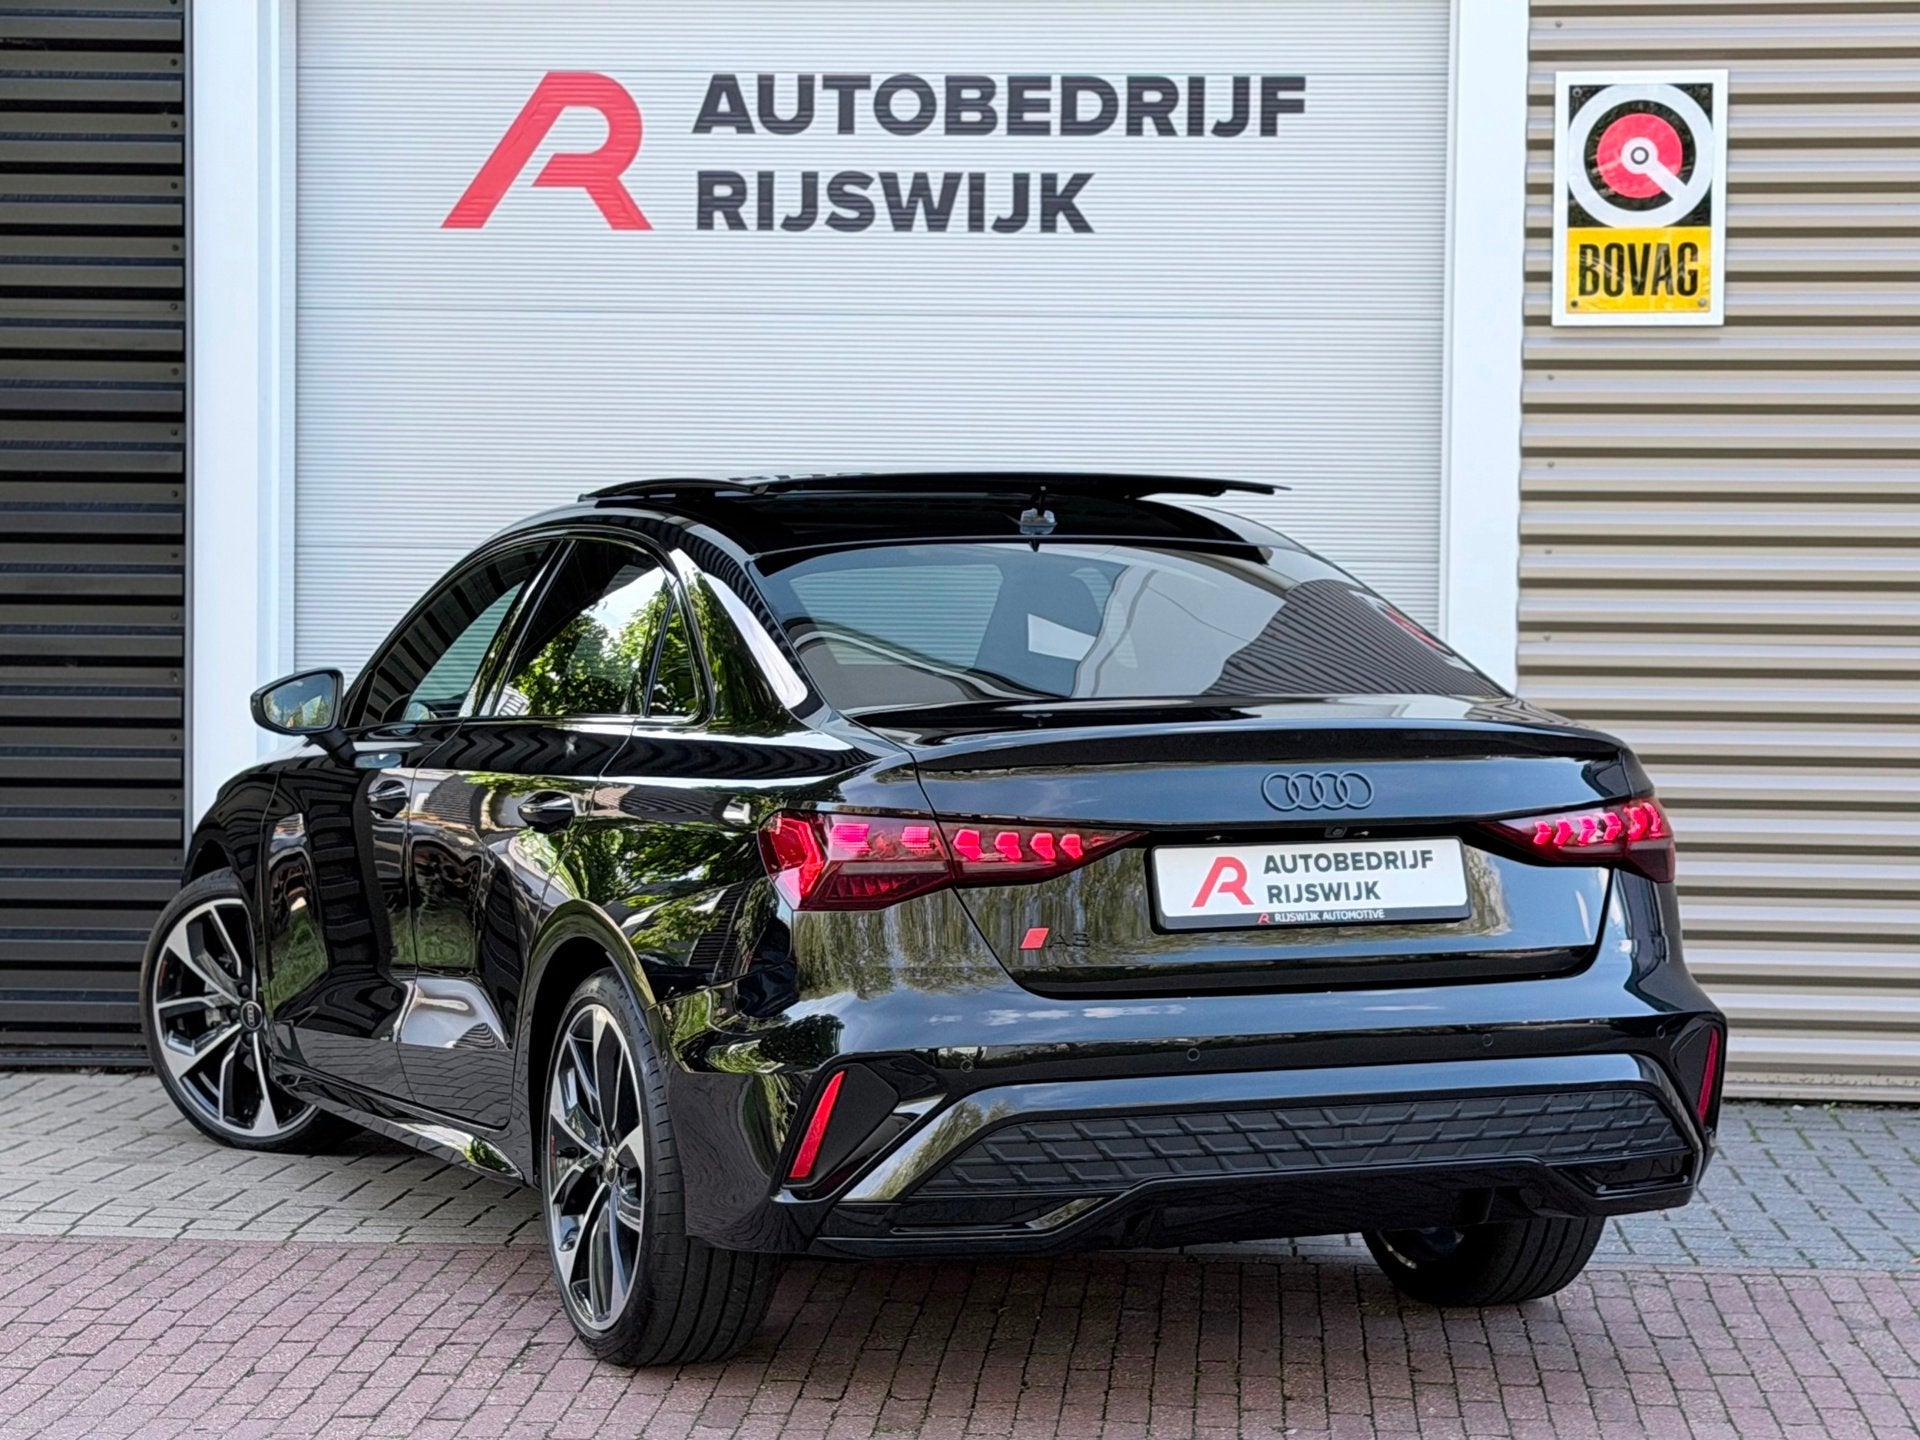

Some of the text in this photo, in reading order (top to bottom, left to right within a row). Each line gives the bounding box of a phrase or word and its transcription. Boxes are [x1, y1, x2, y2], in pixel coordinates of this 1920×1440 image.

[692, 73, 1306, 137] AUTOBEDRIJF
[697, 170, 1093, 234] RIJSWIJK
[1578, 241, 1699, 297] BOVAG
[1263, 849, 1434, 875] AUTOBEDRIJF
[1266, 880, 1381, 904] RIJSWIJK
[1274, 908, 1386, 923] RIJSWIJK AUTOMOTIVE
